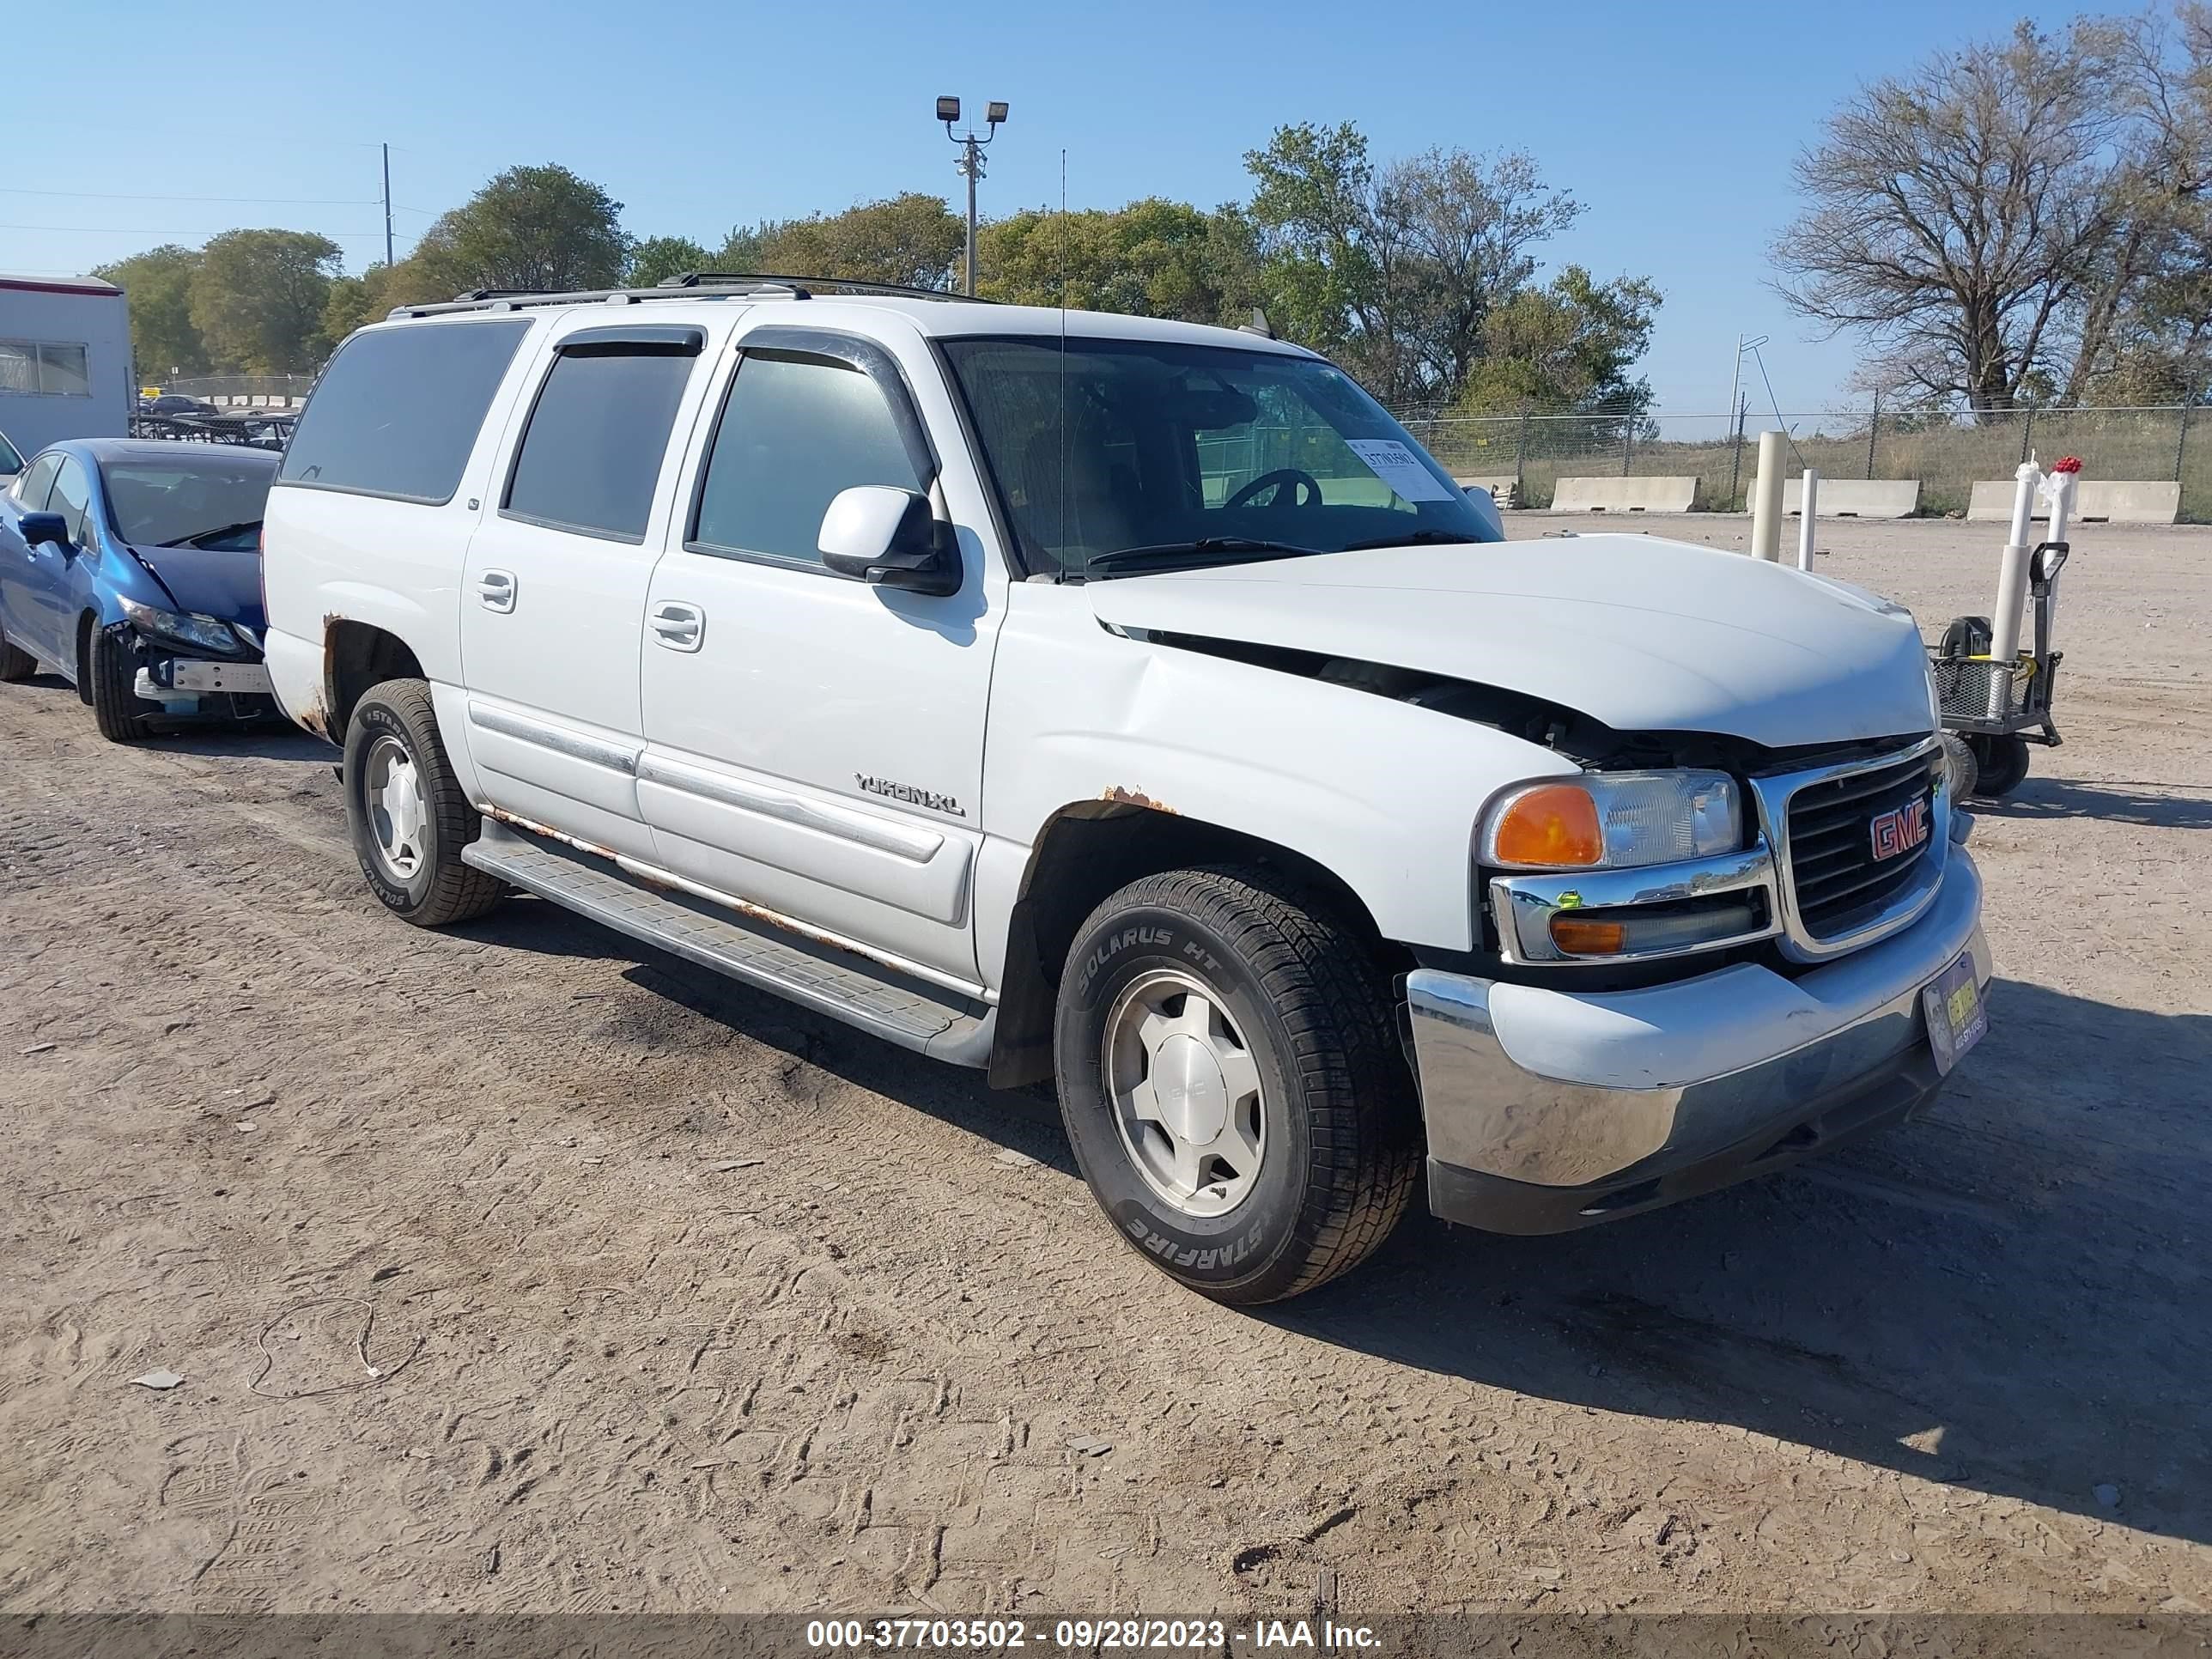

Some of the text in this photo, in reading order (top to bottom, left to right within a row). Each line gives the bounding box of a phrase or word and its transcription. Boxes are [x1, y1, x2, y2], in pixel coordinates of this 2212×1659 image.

[1364, 453, 1415, 465] 37703502
[853, 771, 967, 817] YUKON XL
[1870, 796, 1929, 862] GMC
[1078, 926, 1227, 998] SOLARUS HT
[1126, 1218, 1264, 1271] STARFIRE
